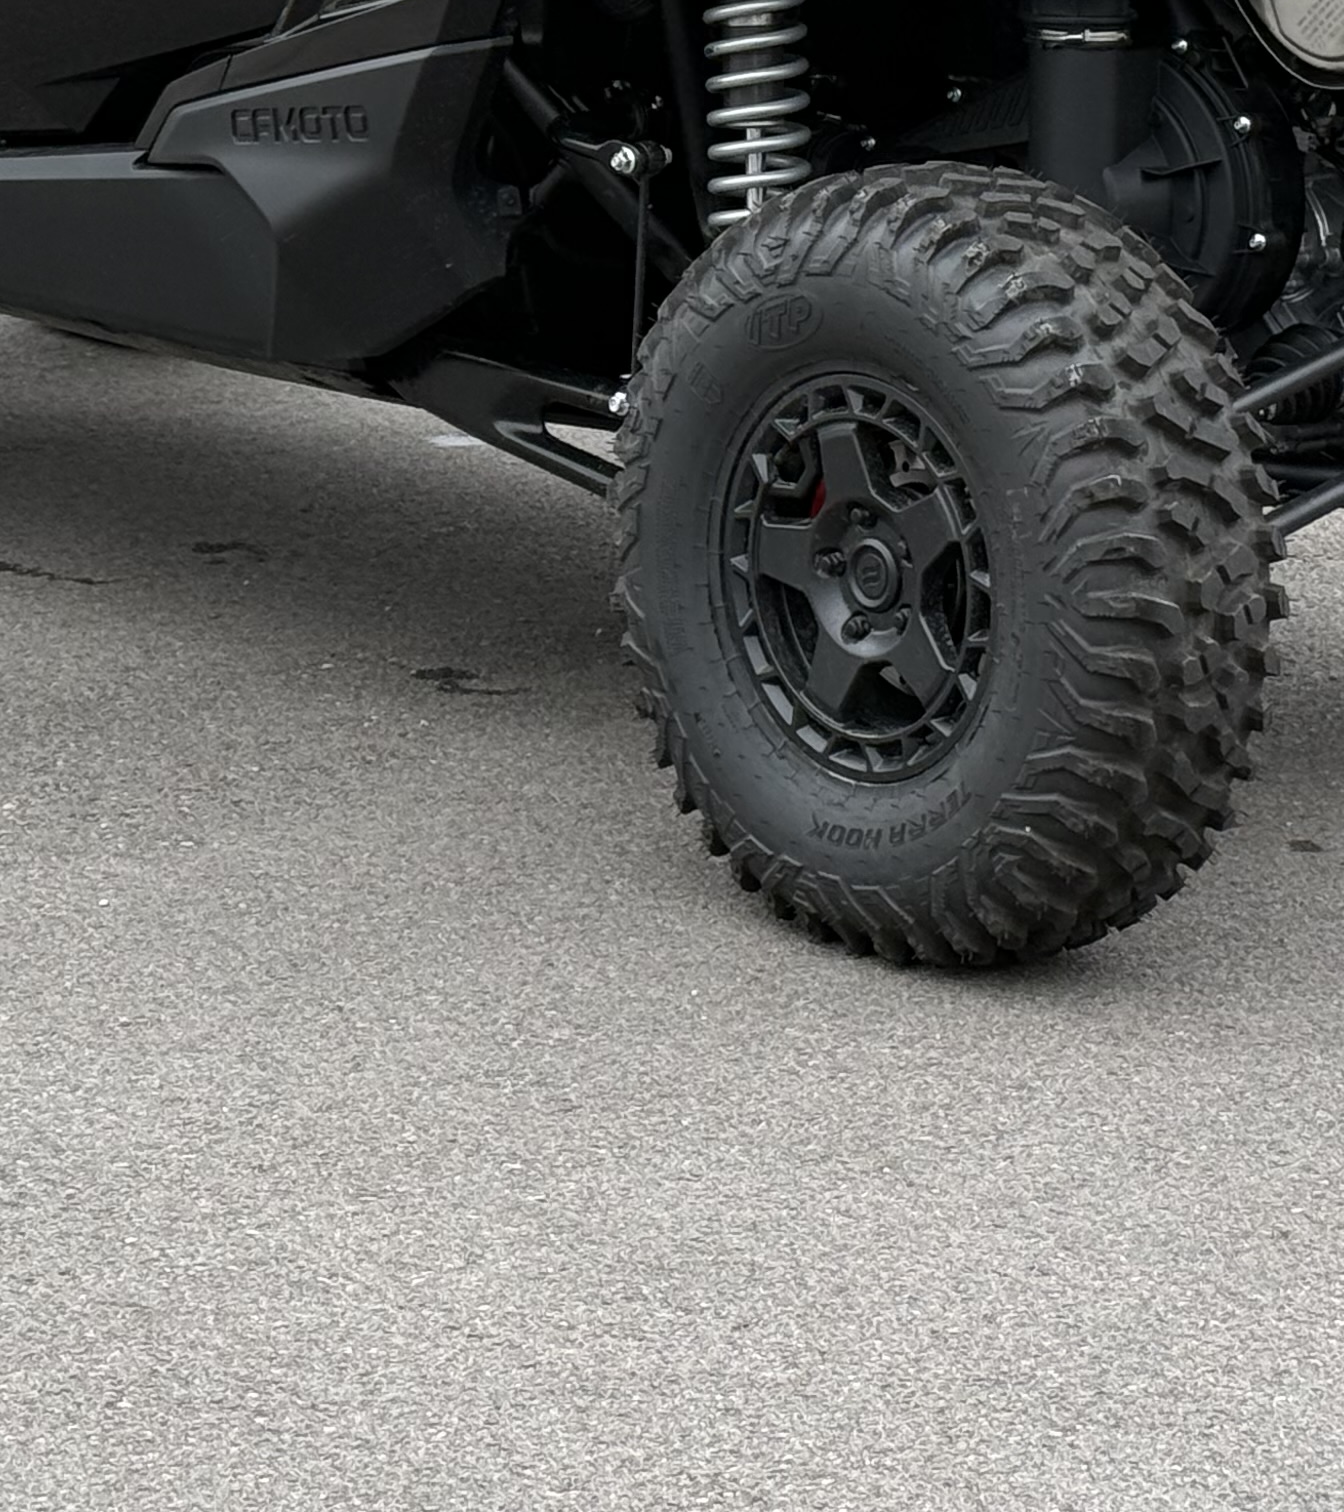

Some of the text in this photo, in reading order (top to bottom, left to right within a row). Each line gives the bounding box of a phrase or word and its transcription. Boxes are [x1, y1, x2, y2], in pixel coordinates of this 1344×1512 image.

[231, 105, 370, 144] CFMOTO
[807, 780, 973, 850] TERRA HOOK
